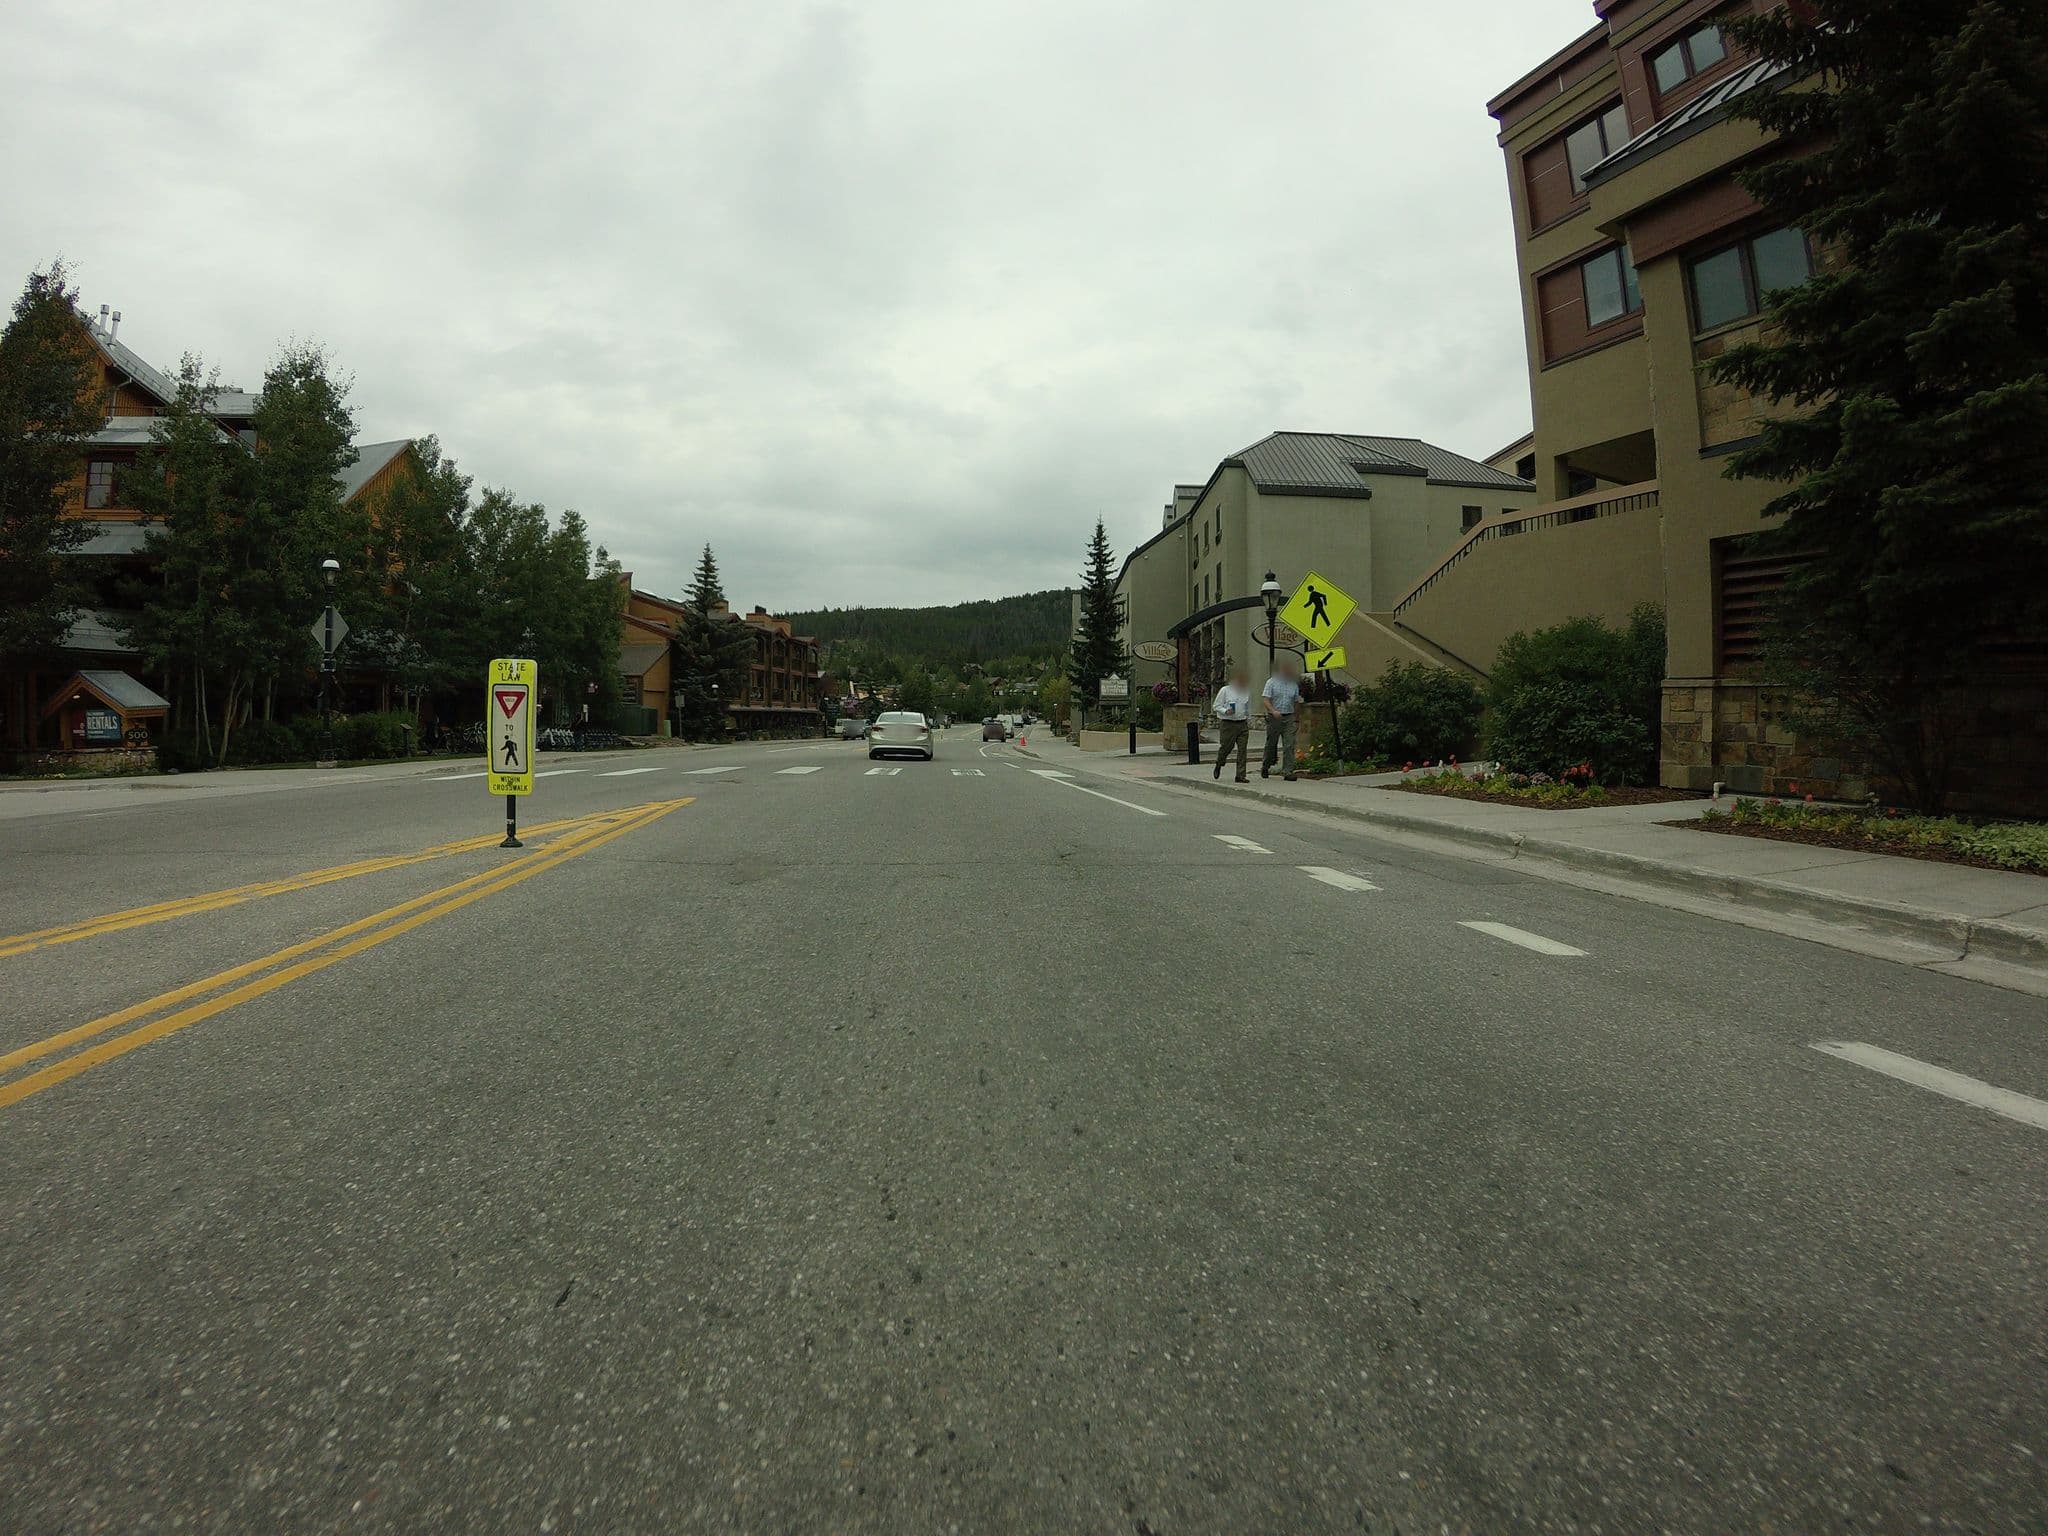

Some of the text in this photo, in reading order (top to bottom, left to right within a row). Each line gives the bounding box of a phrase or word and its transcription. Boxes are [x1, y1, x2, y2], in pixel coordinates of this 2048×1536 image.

[1264, 626, 1298, 645] Vllage
[1142, 644, 1171, 659] Village
[497, 662, 526, 672] STATE
[502, 673, 520, 681] LAW
[87, 715, 118, 730] RENTALS
[505, 724, 514, 732] TO
[128, 731, 148, 740] 500
[492, 784, 528, 792] CROSSWALK
